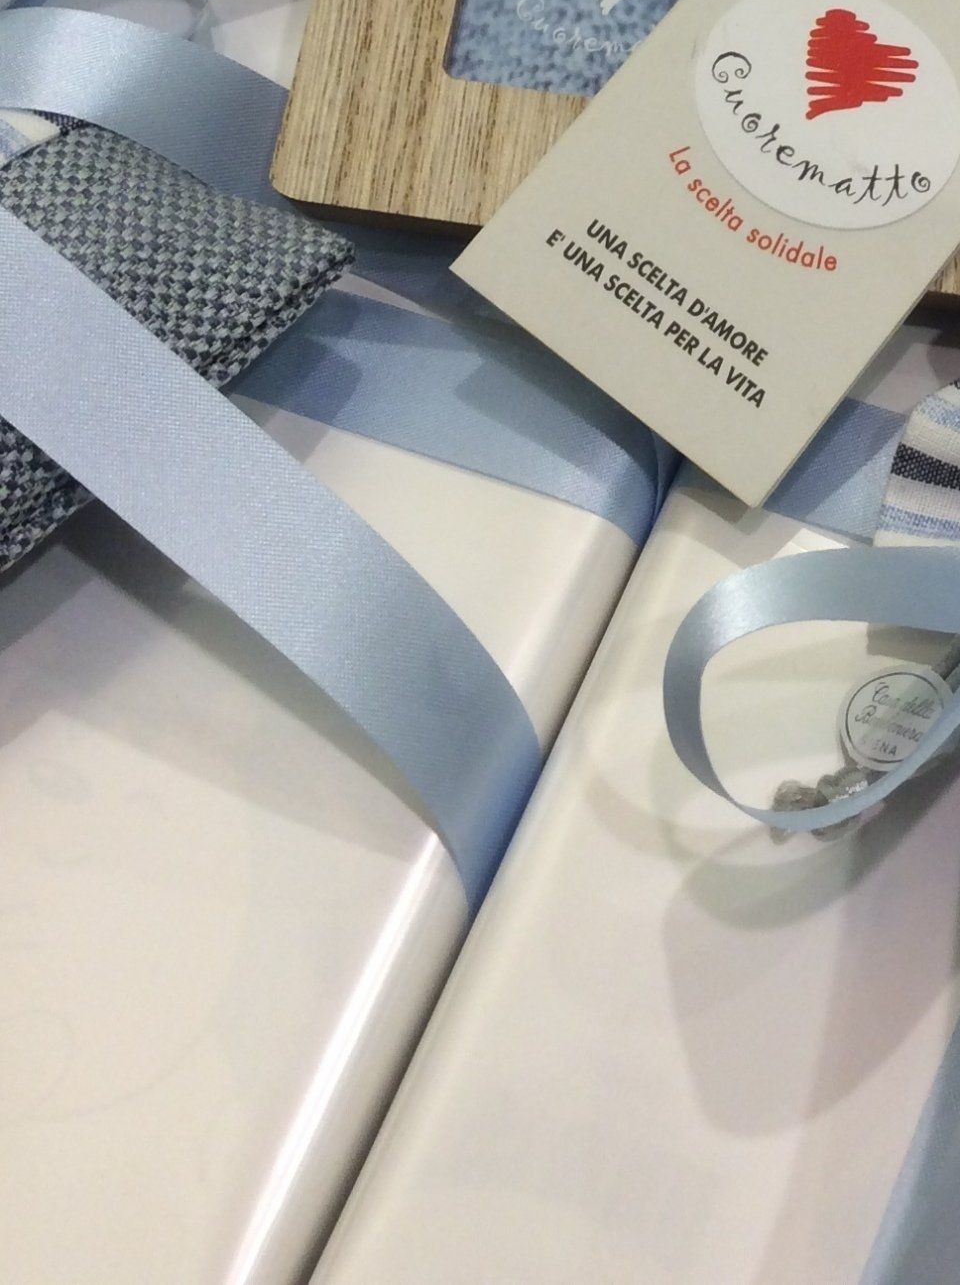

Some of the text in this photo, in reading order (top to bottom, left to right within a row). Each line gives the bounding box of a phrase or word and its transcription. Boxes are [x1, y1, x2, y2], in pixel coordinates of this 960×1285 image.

[711, 51, 931, 207] Cuorematto
[668, 146, 838, 272] La scelta solidale
[546, 229, 766, 408] E' UNA SCELTA PER LA VITA
[586, 218, 768, 367] UNA SCELTA D'AMORE
